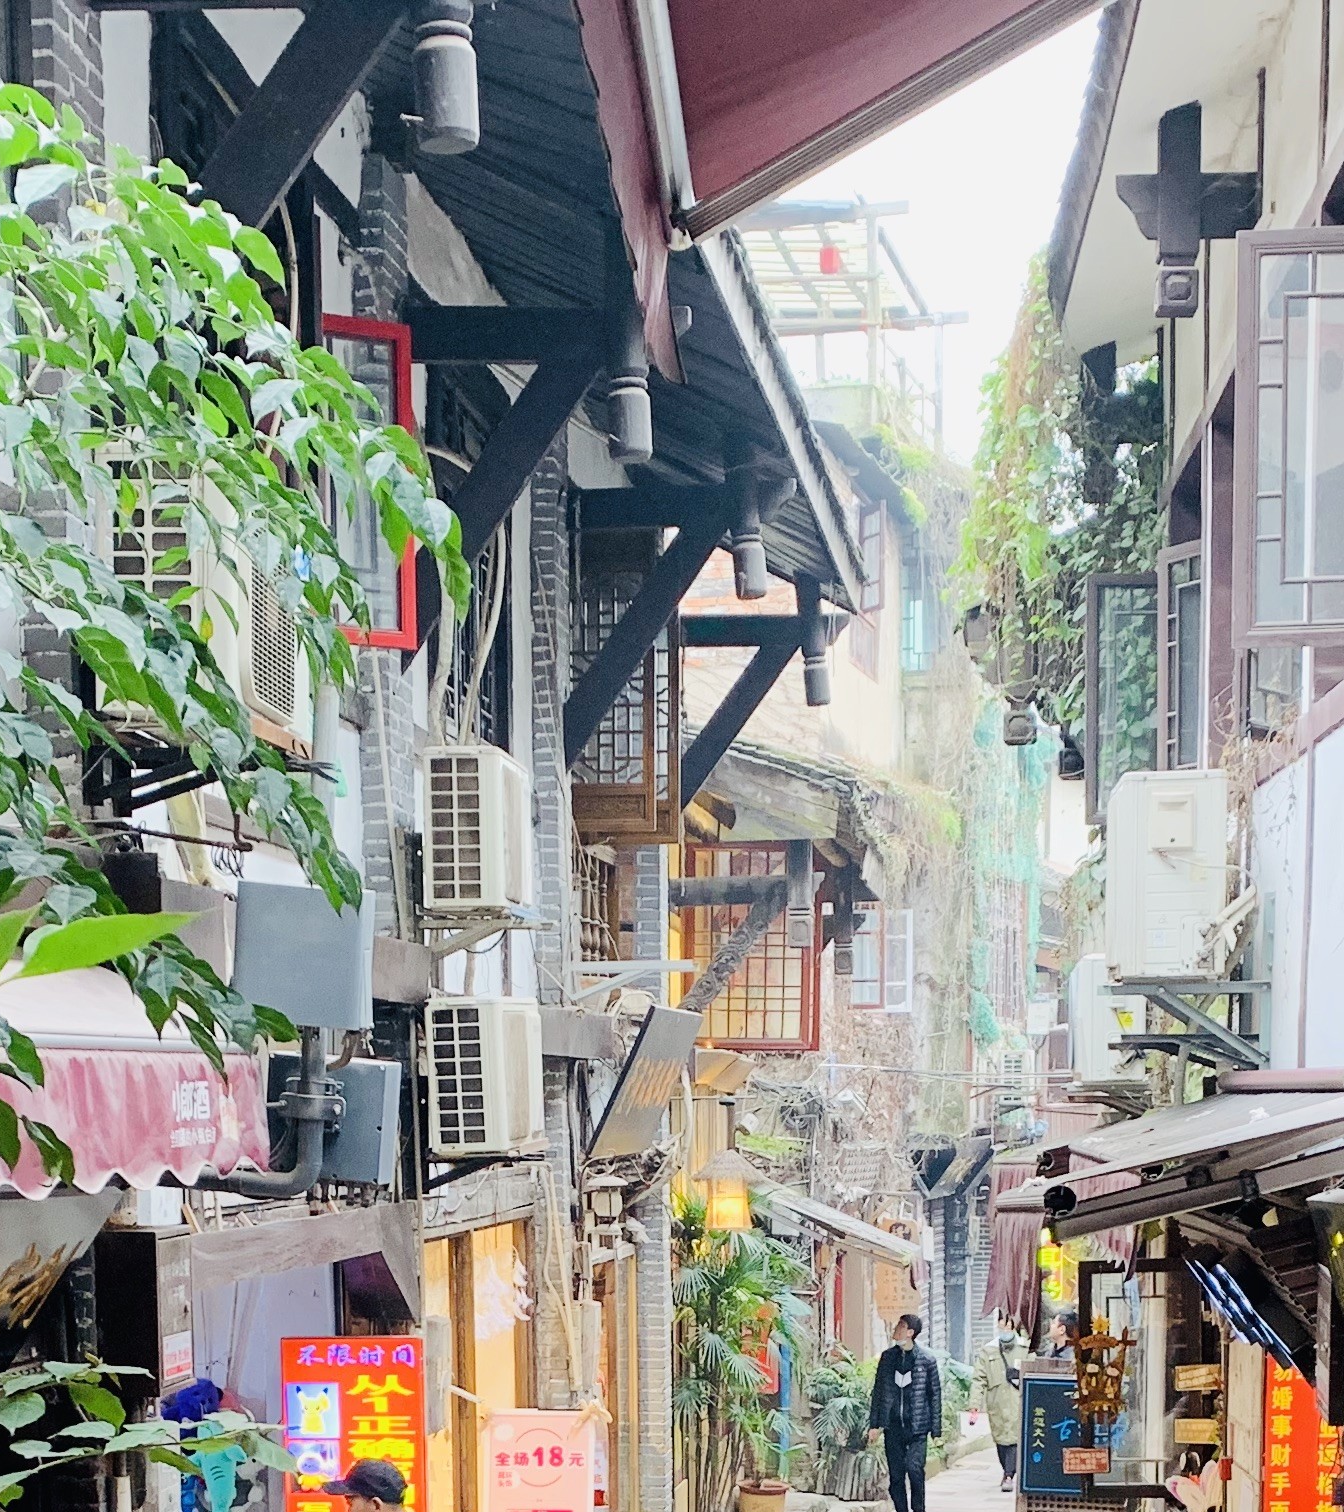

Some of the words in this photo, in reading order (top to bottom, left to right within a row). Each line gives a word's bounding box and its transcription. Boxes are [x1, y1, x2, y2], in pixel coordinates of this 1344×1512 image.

[296, 1344, 415, 1369] 不限时间
[495, 1446, 585, 1468] 全场18元
